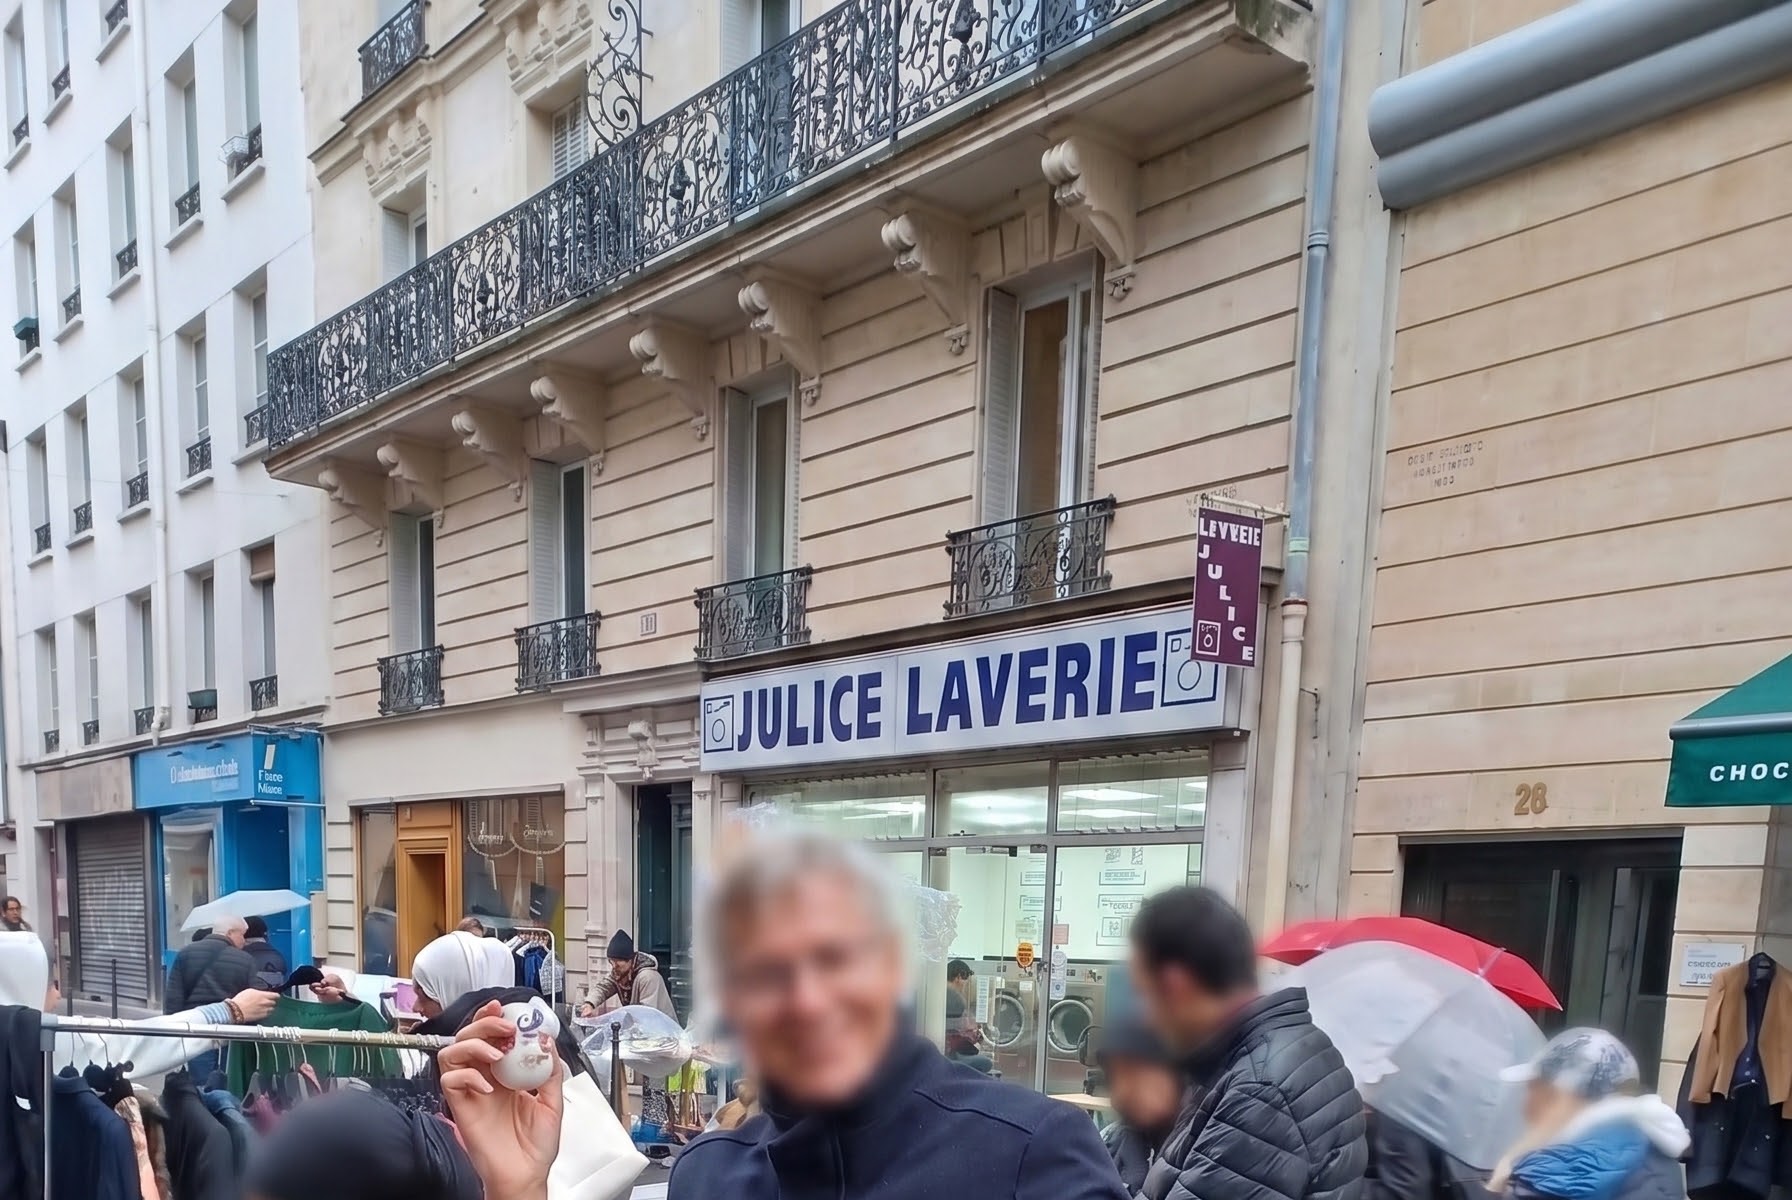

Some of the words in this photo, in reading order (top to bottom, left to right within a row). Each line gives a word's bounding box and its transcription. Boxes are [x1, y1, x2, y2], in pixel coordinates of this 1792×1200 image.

[737, 671, 882, 752] JULICE
[906, 631, 1158, 735] LAVERIE
[1709, 762, 1789, 782] CHOC
[1514, 782, 1548, 815] 28
